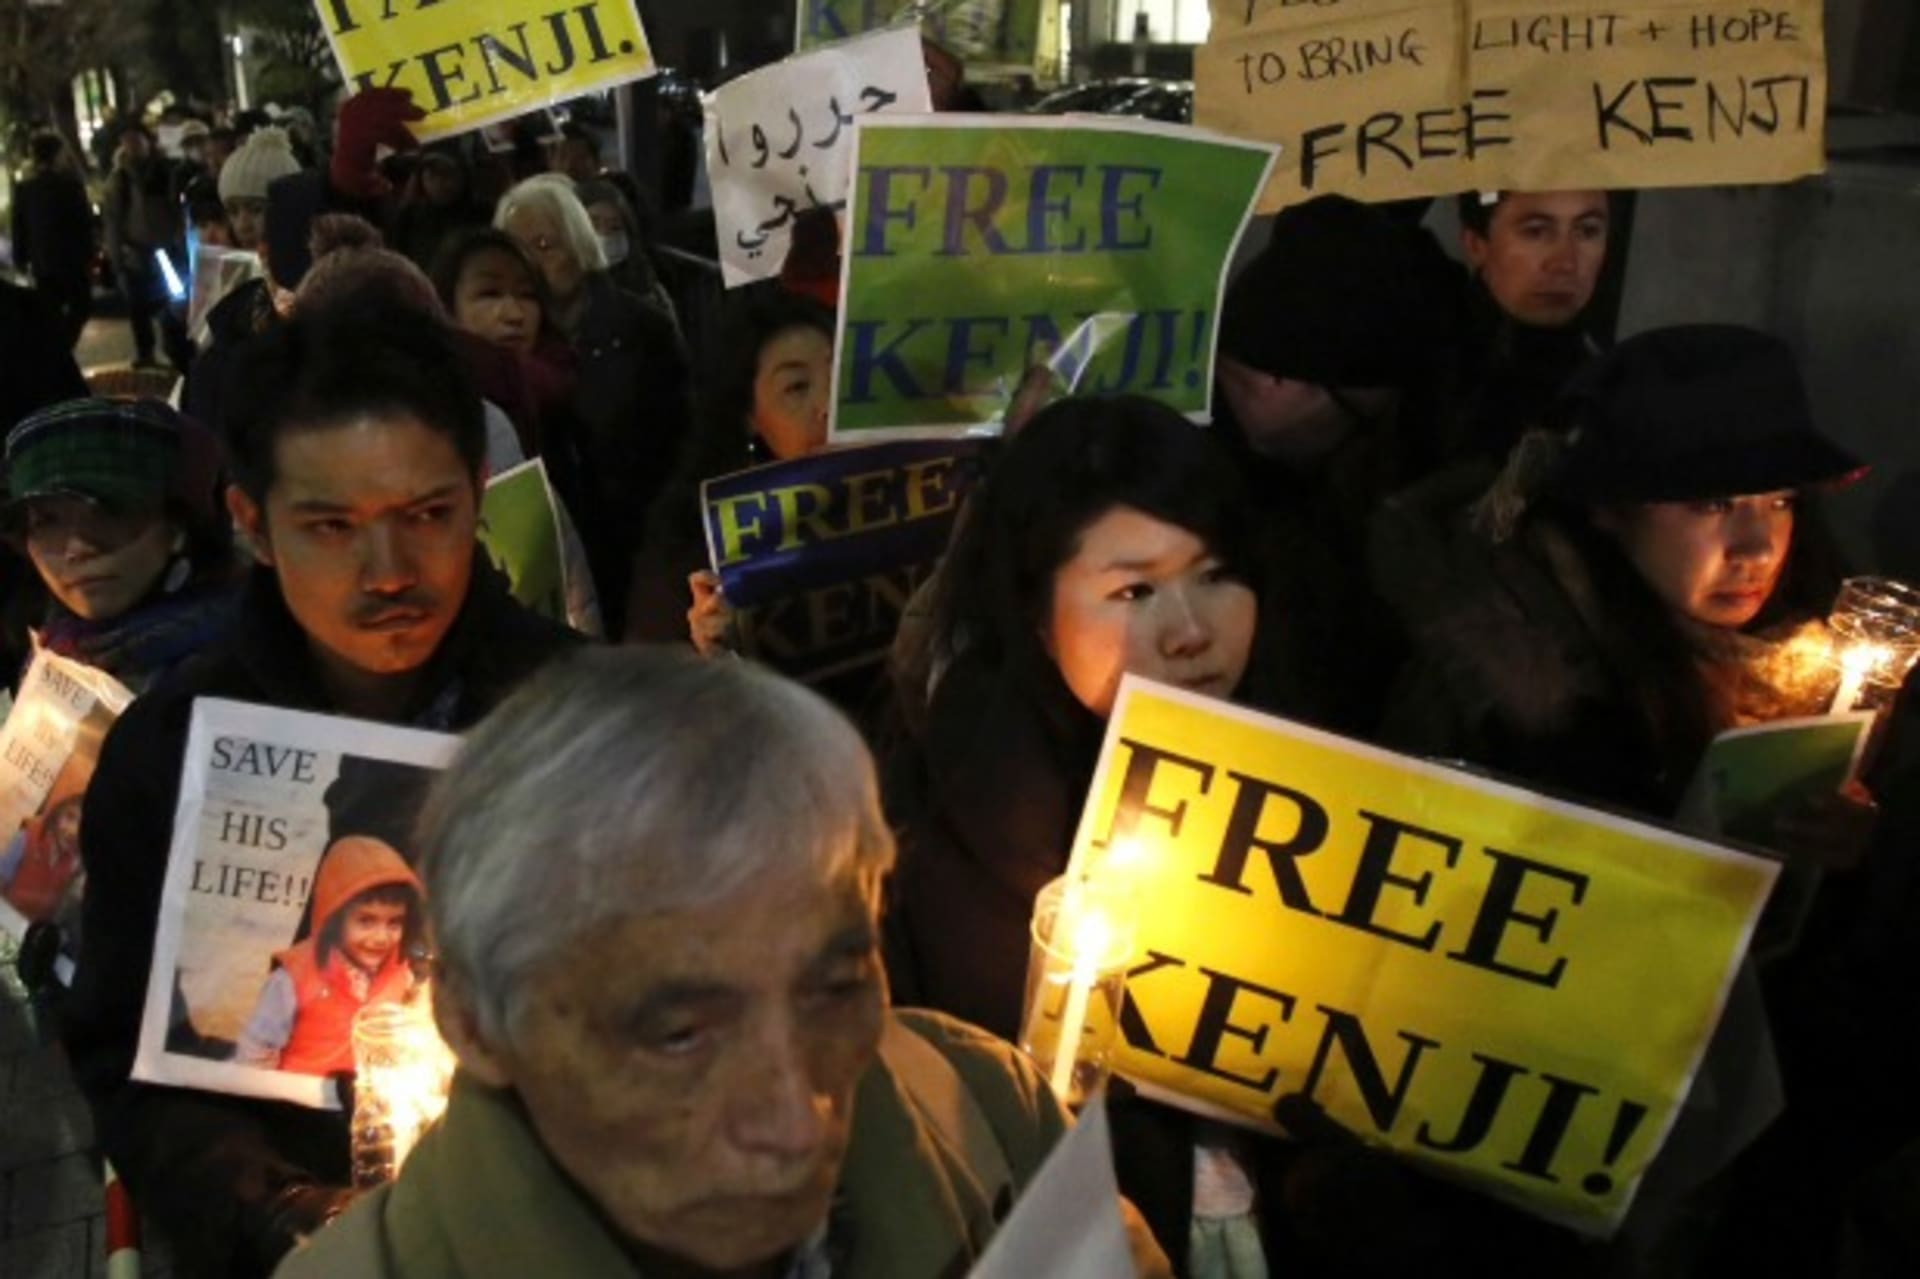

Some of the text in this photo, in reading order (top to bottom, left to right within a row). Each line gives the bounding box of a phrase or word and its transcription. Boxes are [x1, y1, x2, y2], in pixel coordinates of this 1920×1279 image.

[1236, 50, 1286, 93] TO
[1298, 28, 1428, 81] BRING
[1472, 14, 1623, 53] LIGHT
[1689, 11, 1802, 45] HOPE
[1300, 75, 1810, 189] FREE KENJI
[853, 163, 1163, 257] FREE
[708, 457, 956, 565] FREE
[210, 737, 317, 783] SAVE
[219, 810, 289, 850] HIS
[1090, 737, 1590, 990] FREE
[190, 861, 313, 908] LIFE!!
